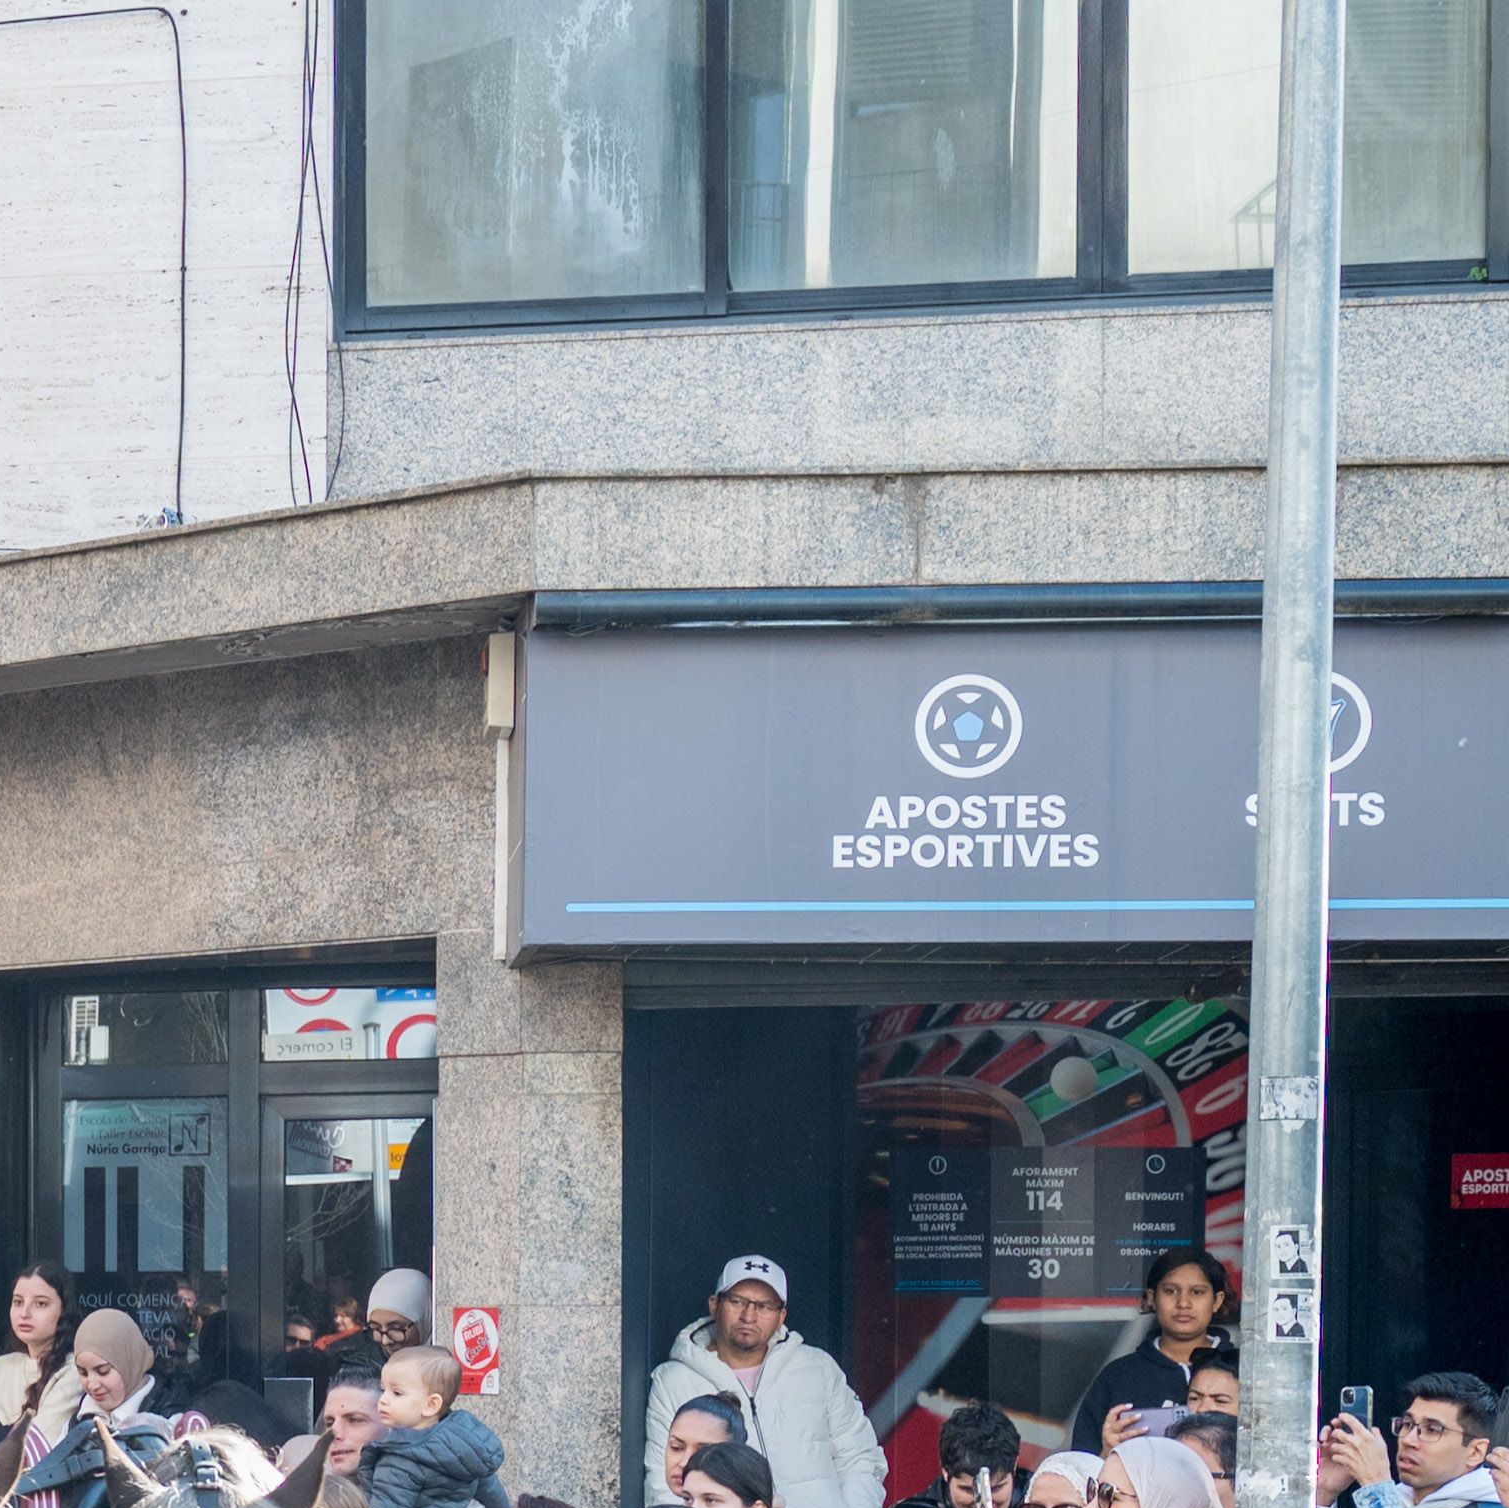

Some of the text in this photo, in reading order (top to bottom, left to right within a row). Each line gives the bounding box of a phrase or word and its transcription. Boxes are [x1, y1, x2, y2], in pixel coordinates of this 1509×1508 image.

[865, 795, 1066, 830] APOSTES
[832, 834, 1100, 869] ESPORTIVES
[87, 1143, 167, 1156] Núria Garriga
[1012, 1167, 1078, 1177] AFORAMENT
[1026, 1177, 1064, 1188] MÀXIM
[912, 1193, 964, 1202] PROHIBIDA
[1026, 1191, 1063, 1211] 114
[1125, 1192, 1184, 1202] BENVINGUT!
[960, 1203, 968, 1211] A
[912, 1213, 965, 1222] MENORS DE
[919, 1223, 957, 1232] 18 ANYS
[1133, 1223, 1176, 1232] HORARIS
[993, 1233, 1096, 1245] NÚMERO MÀXIM DE
[995, 1246, 1094, 1258] MÀQUINES TIPUS B
[1027, 1258, 1060, 1279] 30
[79, 1291, 114, 1308] AQUÍ
[137, 1310, 173, 1324] TEVA
